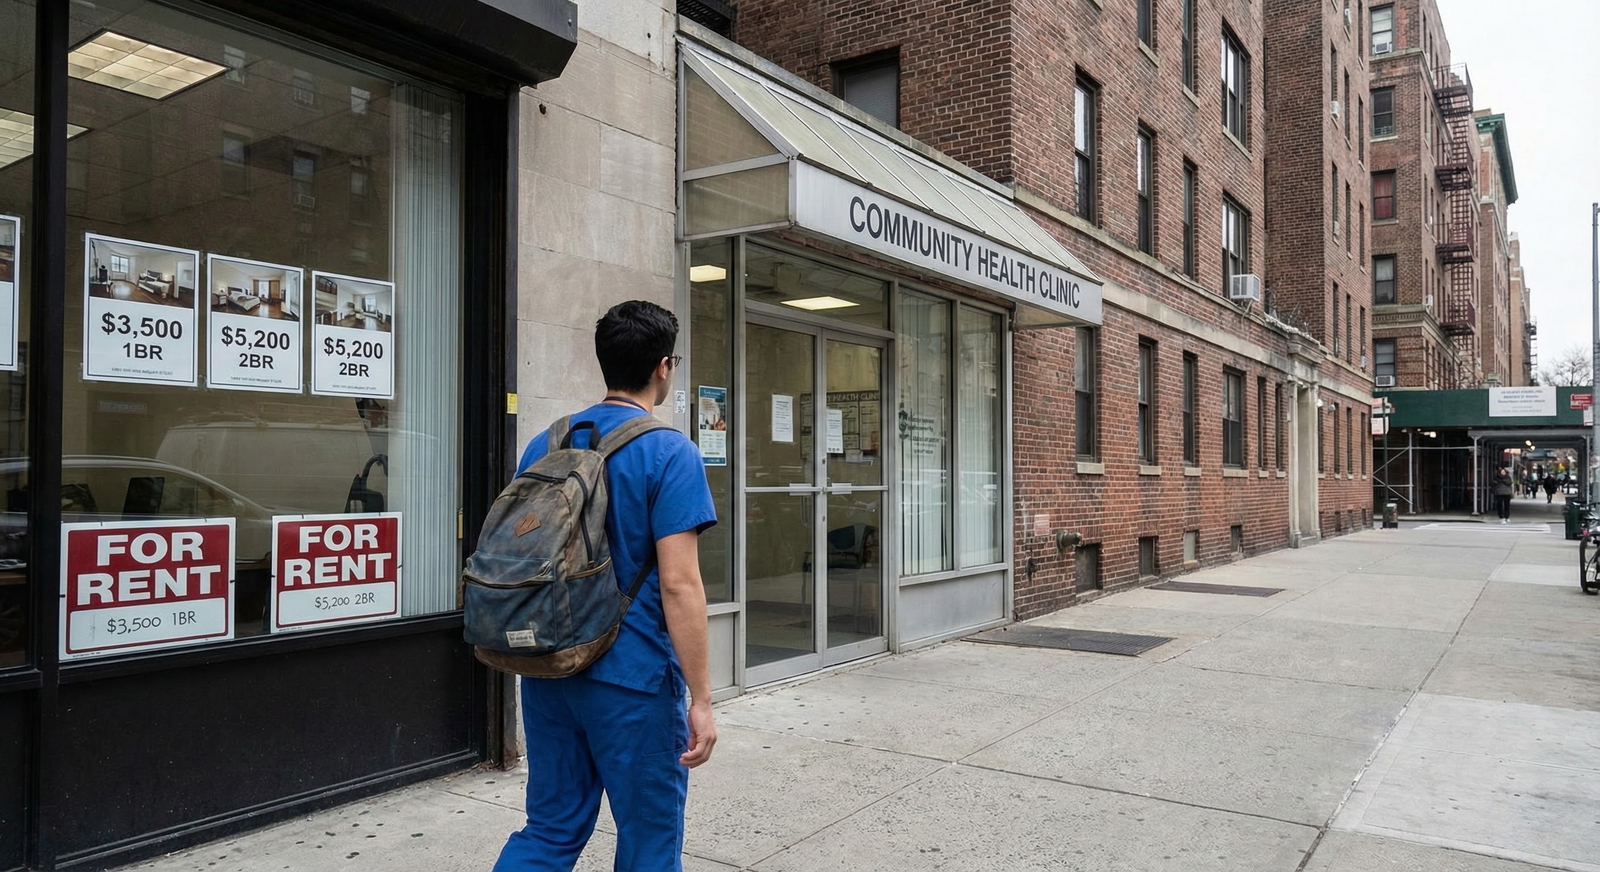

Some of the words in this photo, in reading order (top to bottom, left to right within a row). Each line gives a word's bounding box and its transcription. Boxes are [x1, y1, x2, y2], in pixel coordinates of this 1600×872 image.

[849, 196, 973, 272] COMMUNITY
[978, 245, 1036, 294] HEALTH
[1039, 270, 1080, 309] CLINIC
[101, 311, 183, 340] $3,500
[221, 325, 290, 351] $5,200
[122, 342, 163, 361] 1BR
[238, 352, 274, 370] 2BR
[323, 336, 384, 360] $5,200
[338, 361, 370, 378] 2BR
[97, 531, 204, 567] FOR
[299, 523, 379, 554] FOR
[284, 552, 392, 587] RENT
[76, 564, 222, 606] RENT
[314, 596, 350, 610] $5,200
[354, 592, 375, 606] 2BR
[106, 616, 162, 636] $3,500
[172, 610, 197, 626] 1BR
